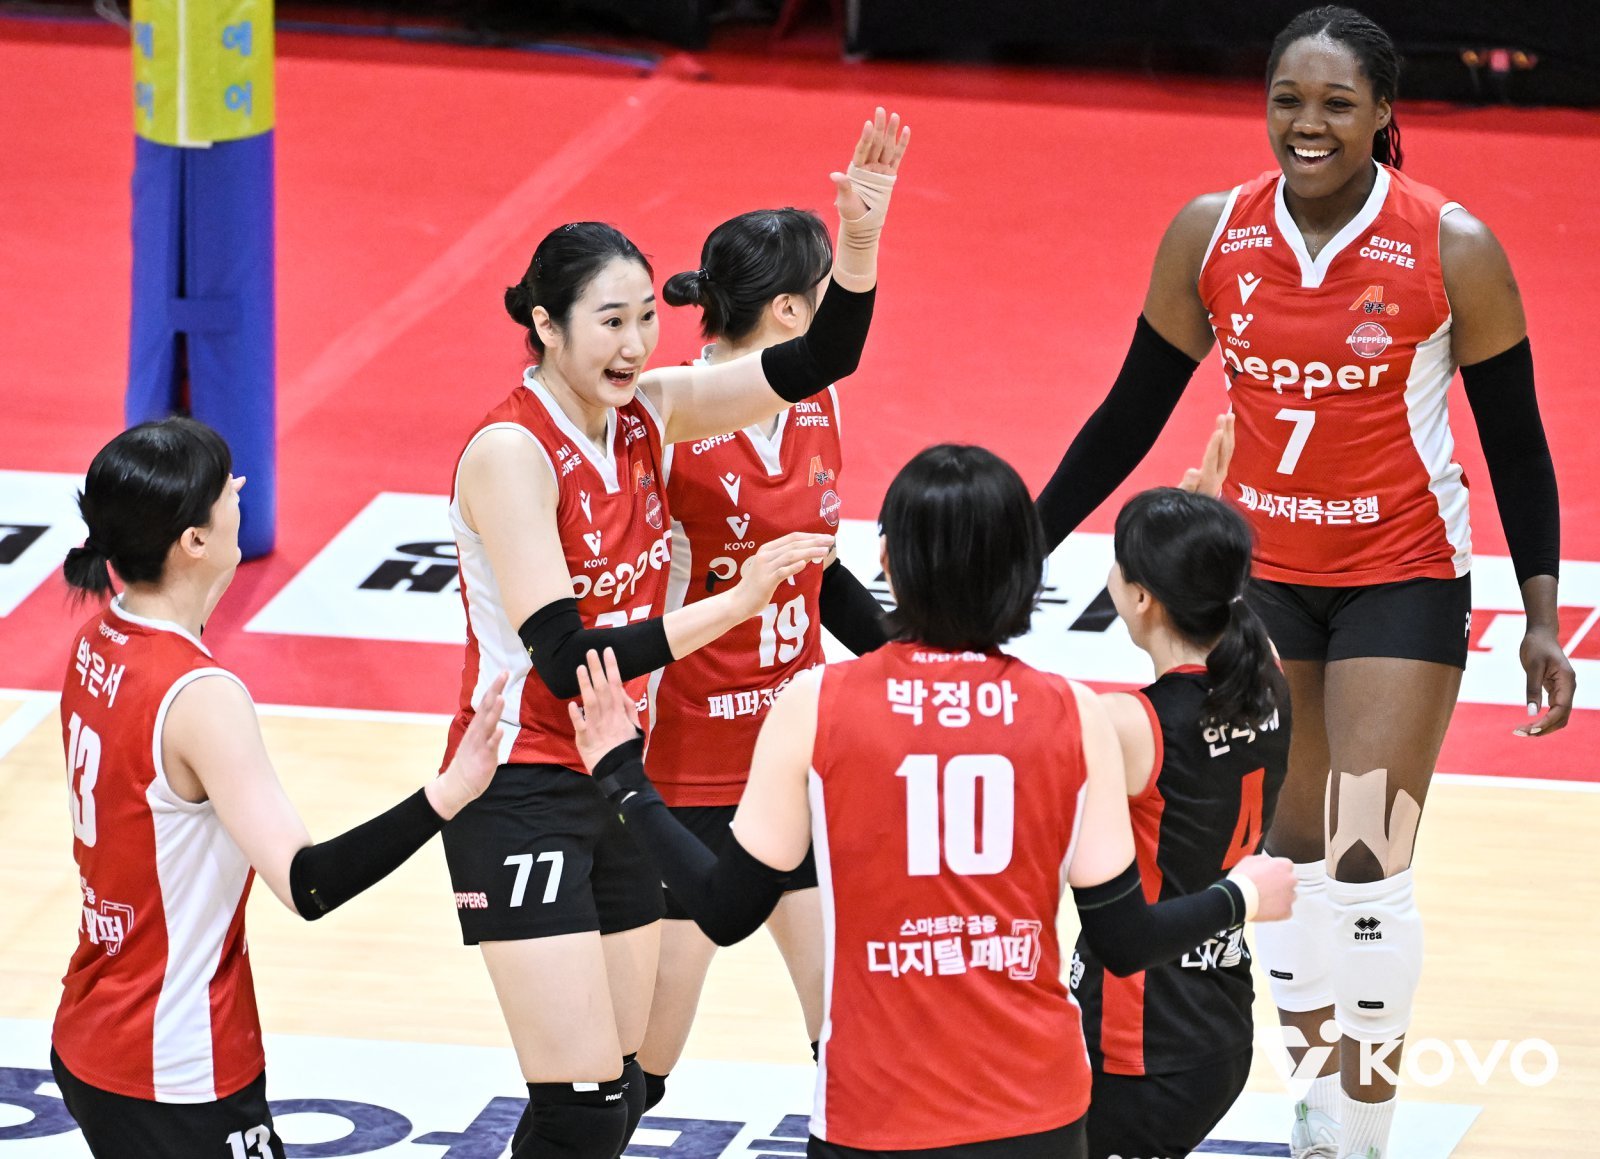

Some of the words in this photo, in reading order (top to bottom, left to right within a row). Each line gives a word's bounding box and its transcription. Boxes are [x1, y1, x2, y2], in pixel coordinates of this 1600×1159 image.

[1220, 237, 1273, 254] COFFEE
[1227, 225, 1267, 240] EDIYA
[1369, 235, 1412, 254] EDIYA
[1359, 247, 1416, 269] COFFEE
[1364, 302, 1386, 315] 광주
[1227, 335, 1250, 349] KOVO
[692, 432, 736, 455] COFFEE
[1274, 408, 1316, 475] 7
[1238, 482, 1379, 525] 페퍼저축은행
[584, 557, 608, 569] KOVO
[724, 541, 755, 551] KOVO
[757, 593, 810, 668] 19
[76, 636, 126, 709] 박은서
[887, 677, 1018, 728] 박정아
[68, 711, 102, 848] 13
[894, 753, 1015, 876] 10
[1221, 767, 1265, 871] 4
[503, 850, 564, 908] 77
[899, 915, 965, 937] 스마트한
[967, 914, 998, 935] 금융
[866, 936, 967, 978] 디지털
[970, 934, 1032, 972] 페퍼
[225, 1123, 275, 1159] 13
